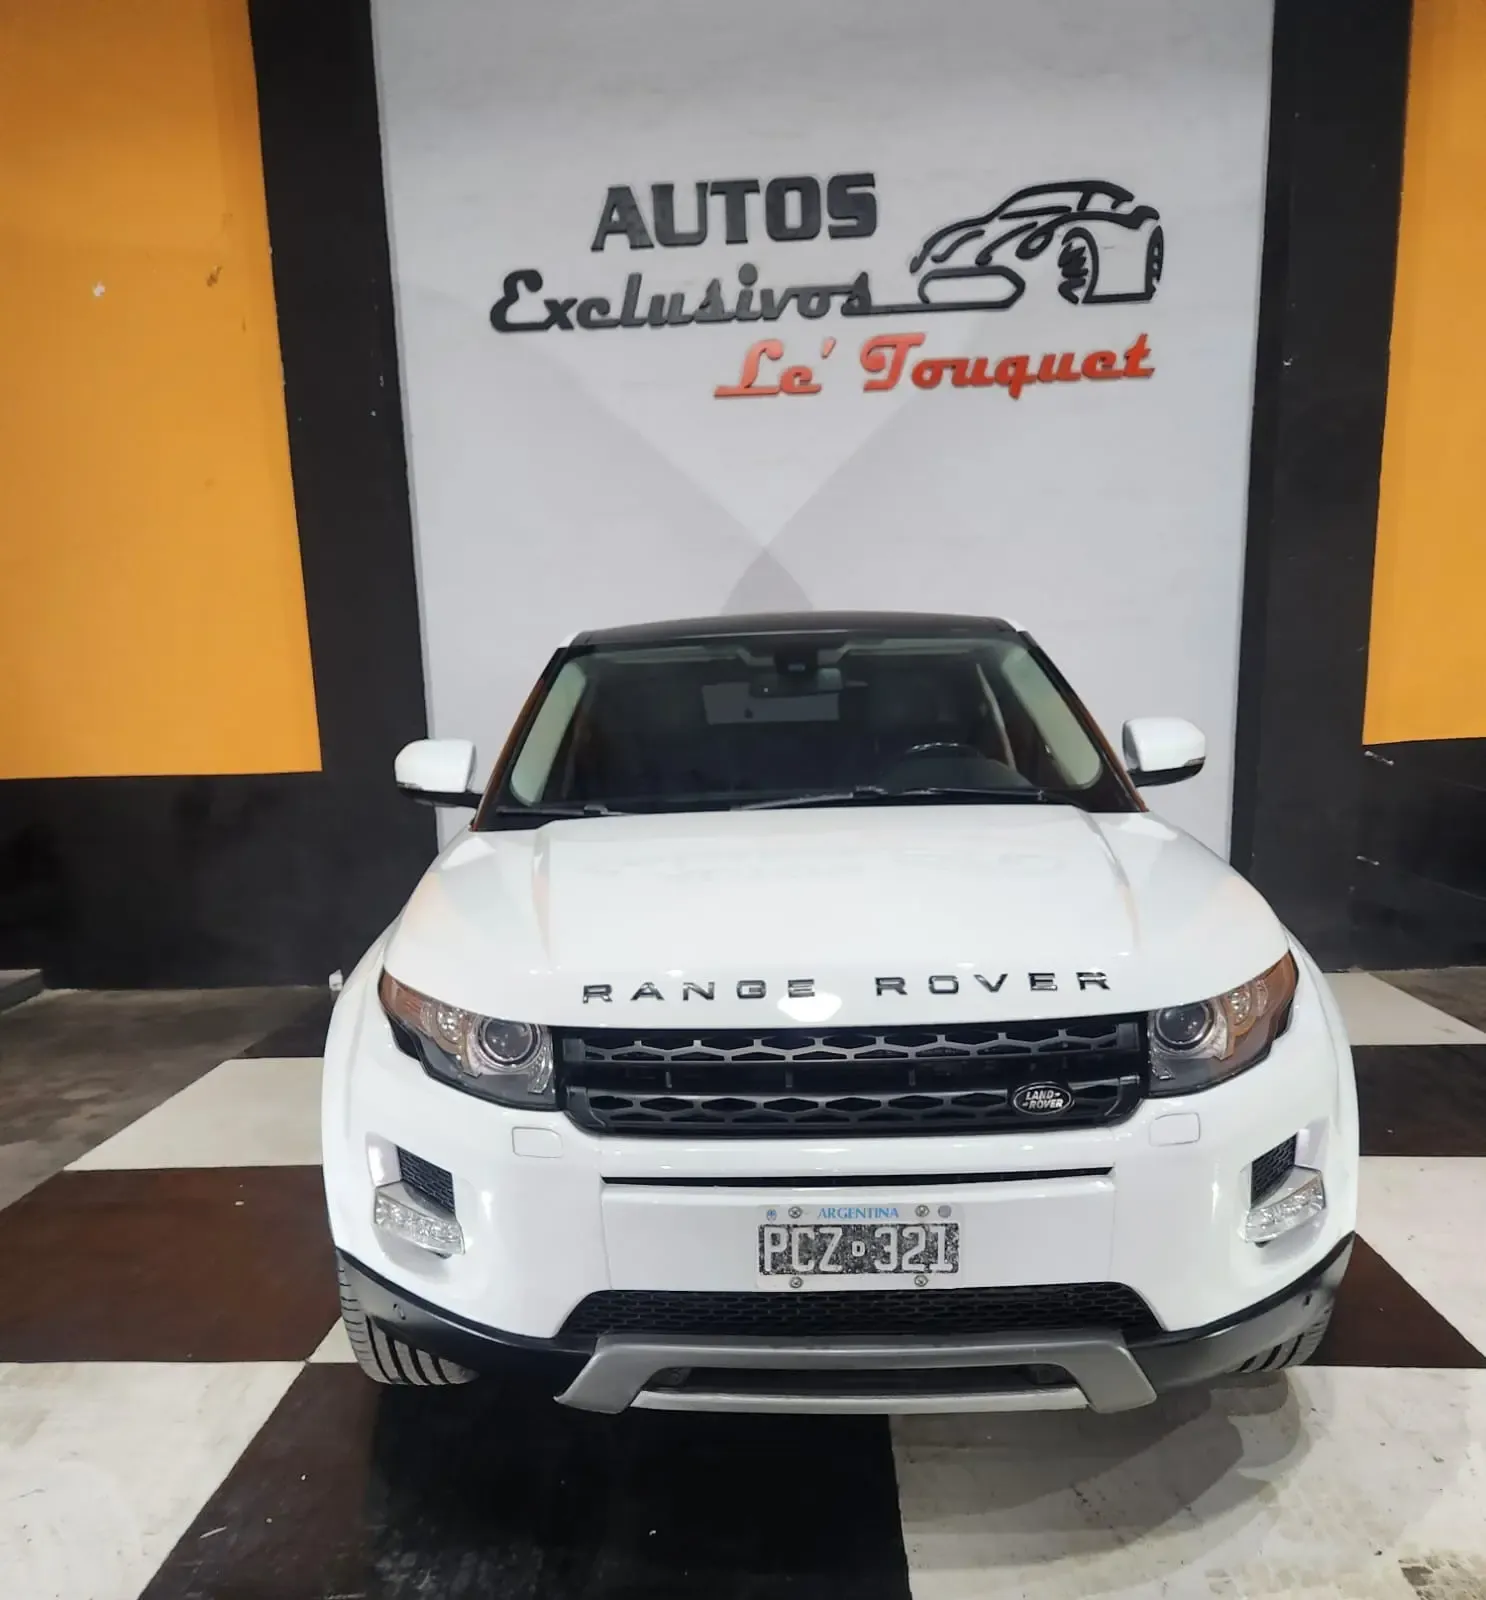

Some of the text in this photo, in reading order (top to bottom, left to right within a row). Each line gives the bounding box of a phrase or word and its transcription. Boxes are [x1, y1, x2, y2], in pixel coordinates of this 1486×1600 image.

[590, 172, 877, 252] AUTOS
[490, 263, 873, 332] Exclusivos
[858, 332, 1155, 400] Touquet
[581, 971, 1112, 1004] RANGE ROVER
[817, 1207, 900, 1220] ARGENTINA
[763, 1226, 843, 1273] PCZ
[874, 1226, 953, 1273] 321
